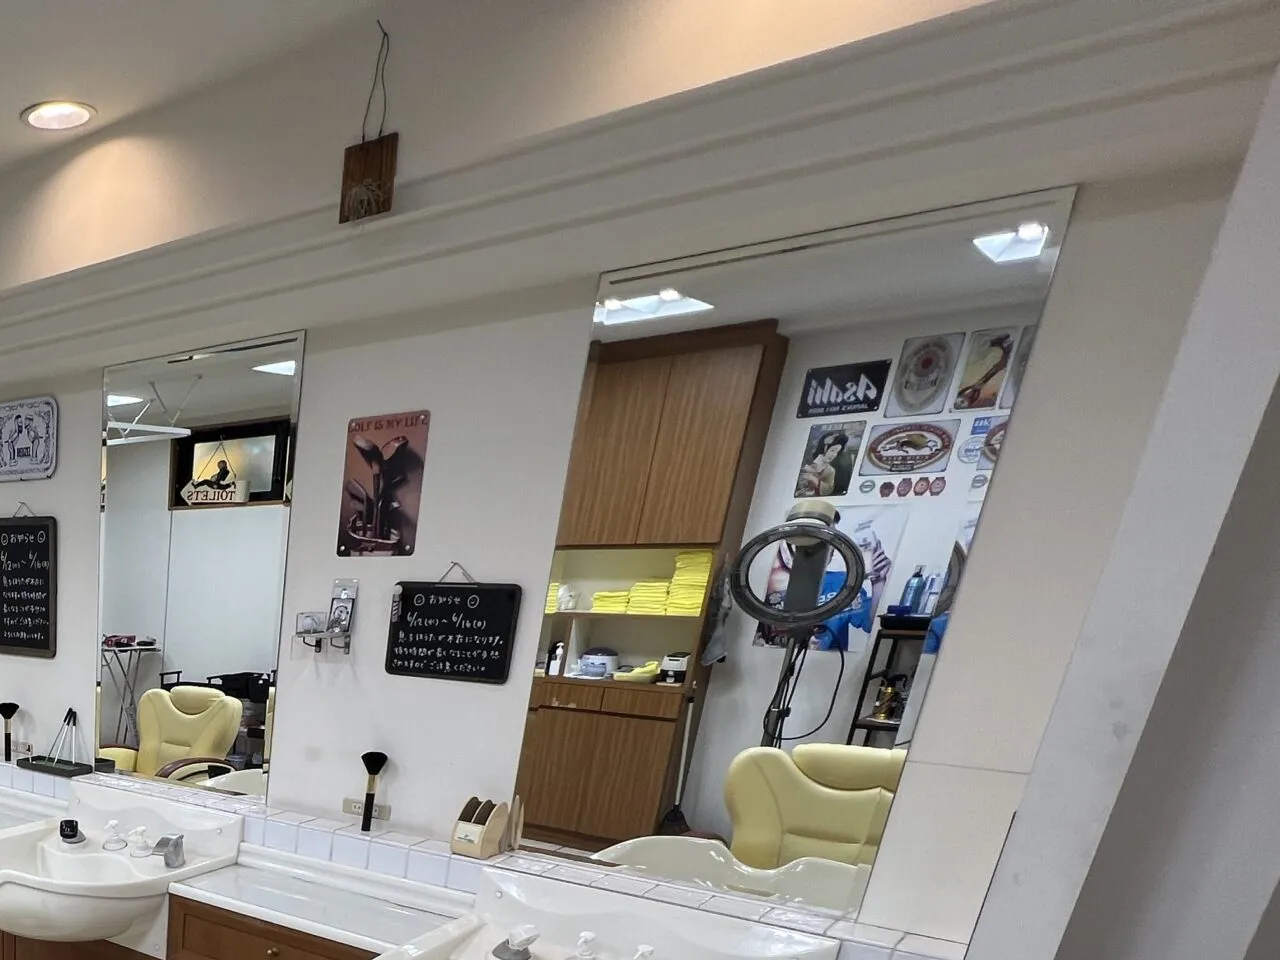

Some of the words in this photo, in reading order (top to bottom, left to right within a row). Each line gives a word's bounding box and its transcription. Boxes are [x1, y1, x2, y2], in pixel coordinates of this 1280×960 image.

[375, 421, 384, 431] IS
[387, 418, 402, 429] MY
[429, 595, 461, 605] お知らせ
